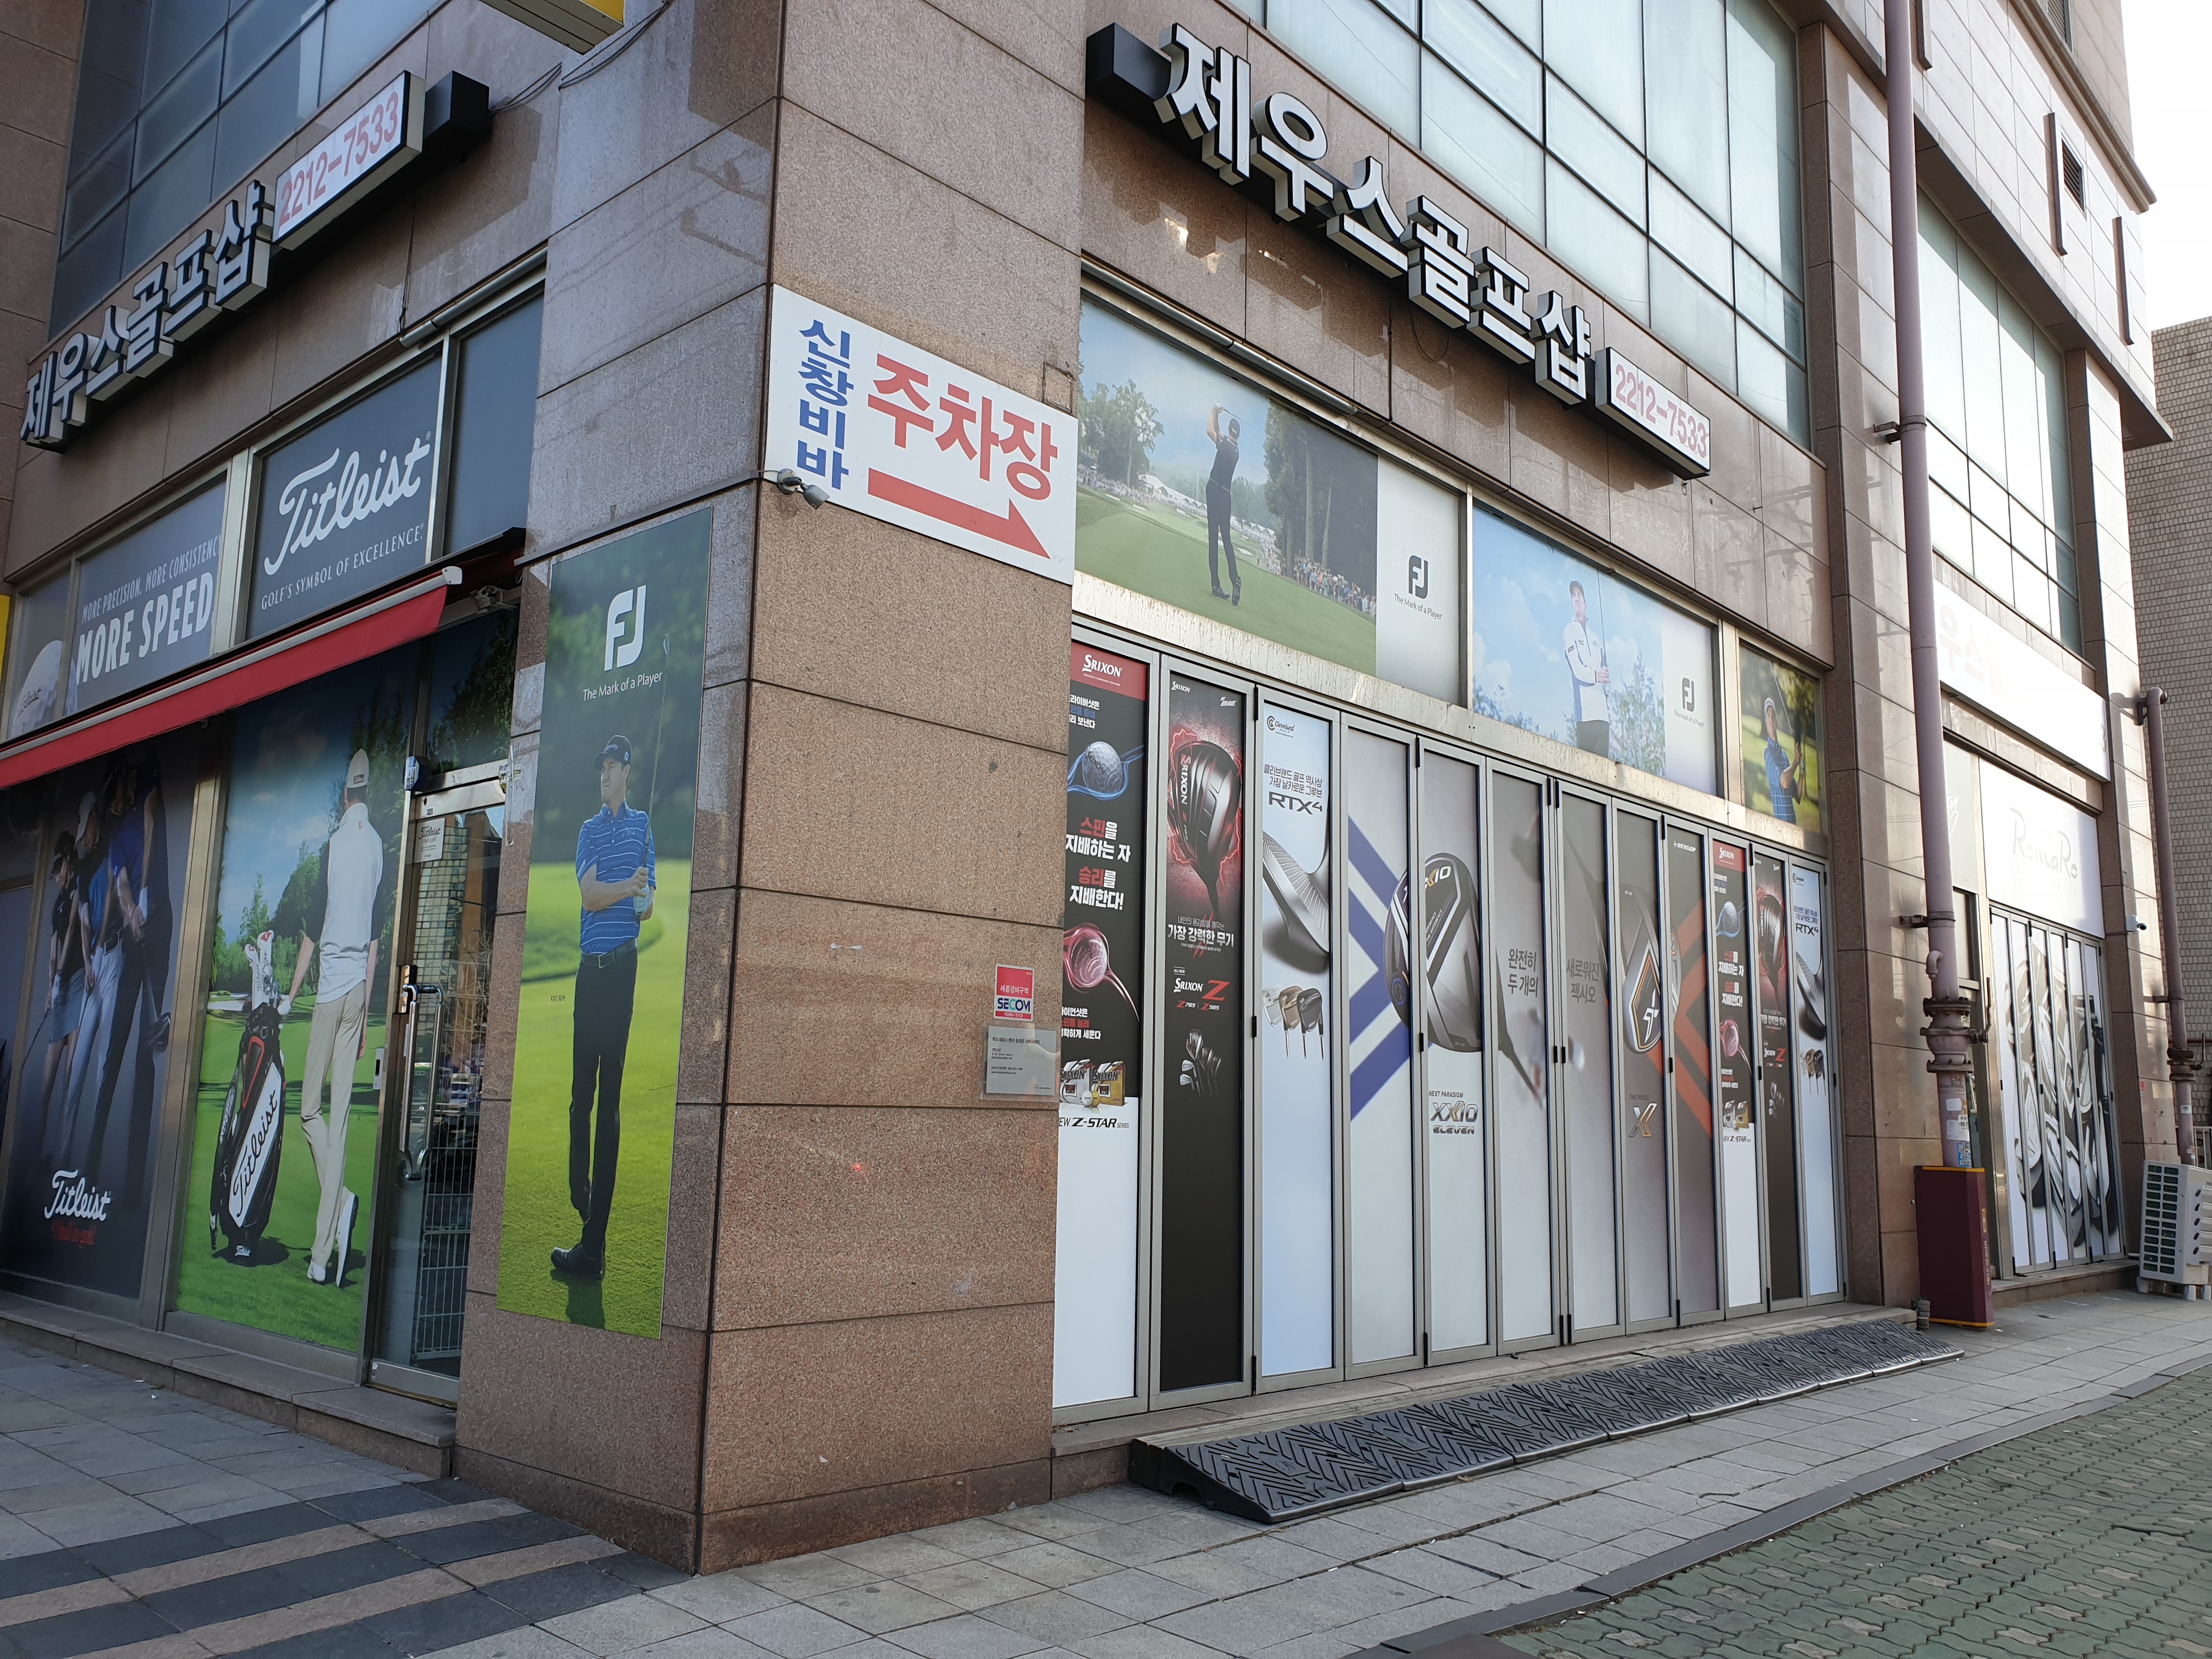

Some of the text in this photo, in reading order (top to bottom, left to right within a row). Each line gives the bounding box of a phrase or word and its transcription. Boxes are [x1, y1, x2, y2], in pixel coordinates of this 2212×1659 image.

[279, 91, 399, 228] 2212-7533
[1158, 22, 1592, 406] 제우스골프샵
[20, 180, 268, 442] 제우스골프샵
[797, 319, 854, 490] 신창비바
[1615, 364, 1707, 459] 2212-7533
[867, 353, 1058, 501] 주차장
[264, 437, 431, 575] Titleist
[261, 583, 292, 610] GOLF'S
[295, 566, 332, 595] SYMBOL
[336, 557, 350, 576] OF
[1408, 555, 1429, 600] FJ
[82, 597, 102, 624] MORE
[102, 576, 142, 614] PRECISION.
[145, 563, 167, 592] MORE
[1394, 593, 1403, 605] The
[1404, 598, 1417, 610] Mark
[1418, 604, 1423, 612] of
[1427, 607, 1443, 620] Player
[76, 572, 214, 686] MORE SPEED
[604, 585, 646, 672] FJ
[1081, 654, 1122, 678] SRIXON
[583, 671, 663, 702] The Mark of a Player
[1171, 681, 1190, 693] SRIXON
[1681, 677, 1695, 712] FJ
[1077, 716, 1096, 729] 보낸다
[1274, 720, 1295, 731] Cleveland
[1085, 751, 1106, 776] SRIXON
[1263, 764, 1323, 788] 클리브랜드 골프 역사상
[1180, 754, 1191, 805] SRIXON
[1269, 776, 1323, 798] 가장 날카로운 그루브
[1268, 791, 1323, 815] RTX4
[1079, 817, 1118, 840] 스핀을
[1065, 834, 1131, 862] 지배하는 자
[1677, 843, 1696, 852] DUNLOP
[1079, 866, 1116, 889] 승리를
[1069, 885, 1124, 910] 지배한다!
[1167, 924, 1187, 941] 가장
[1188, 927, 1215, 945] 강력한
[1217, 932, 1234, 948] 무기
[1796, 923, 1819, 936] RTX4
[1508, 947, 1537, 973] 완전히
[1566, 957, 1599, 982] 새로워진
[1173, 978, 1231, 1001] SRIXON Z
[1507, 973, 1538, 998] 두 개의
[1571, 983, 1596, 1005] 젝시오
[997, 997, 1030, 1012] SECOM
[1062, 1006, 1088, 1018] 이언샷은
[1061, 1028, 1101, 1040] 확하게 세운다
[1092, 1070, 1120, 1083] SRIXON
[1071, 1117, 1117, 1127] Z-STAR
[1433, 1125, 1474, 1135] ELEVEN
[233, 1089, 278, 1217] Titleist
[44, 1169, 111, 1221] Titleist
